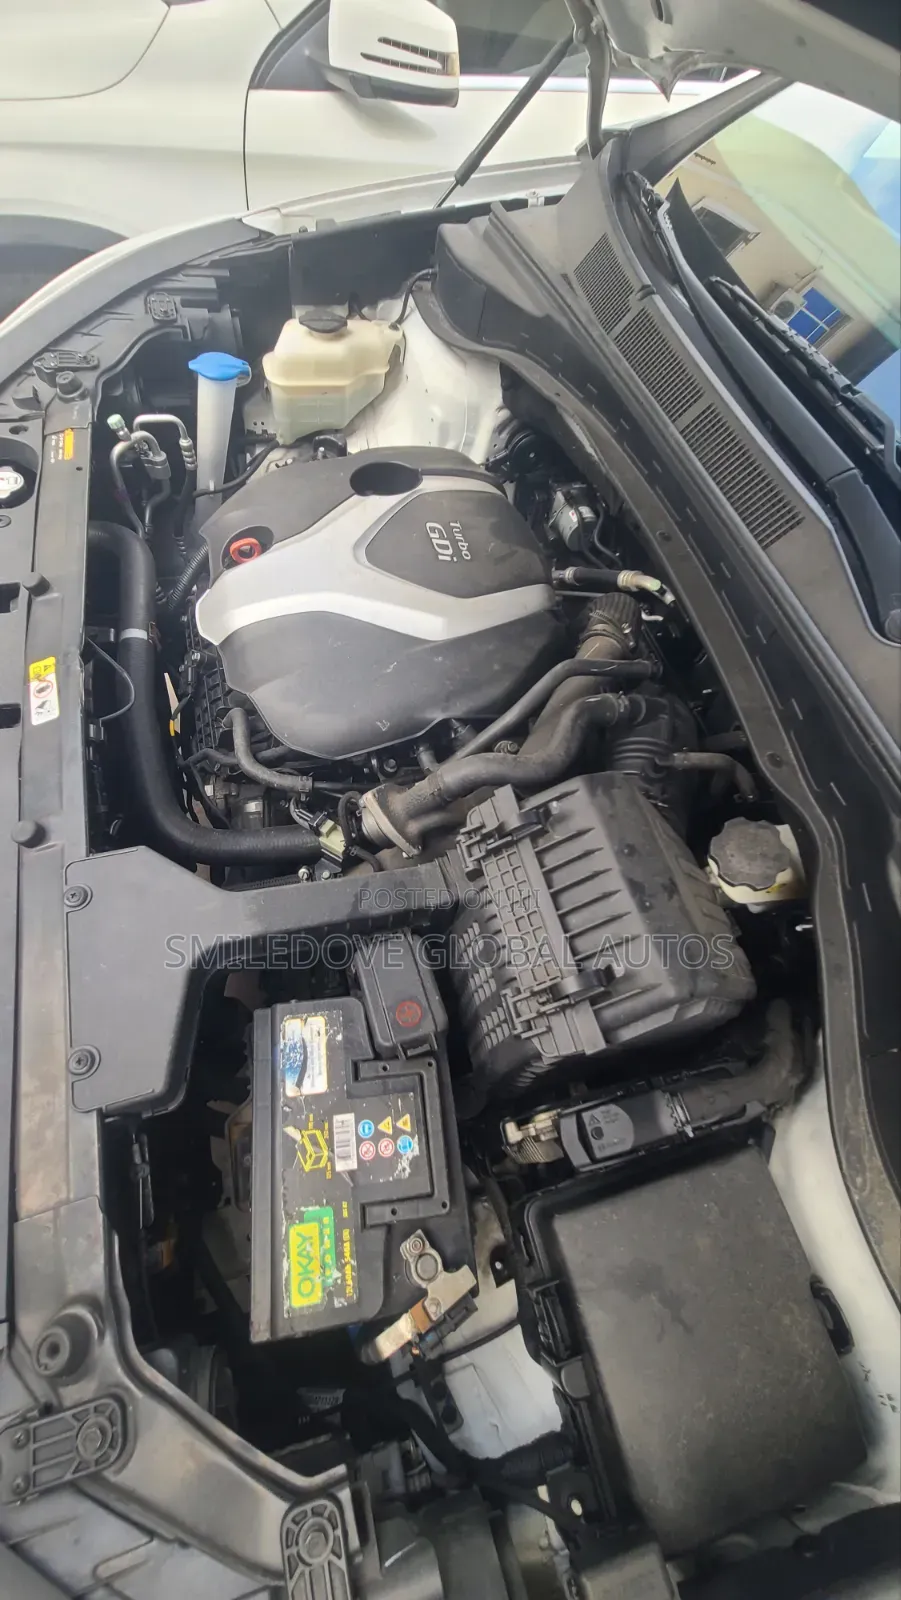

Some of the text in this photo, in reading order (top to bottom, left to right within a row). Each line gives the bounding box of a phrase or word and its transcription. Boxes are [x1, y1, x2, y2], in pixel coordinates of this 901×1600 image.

[425, 522, 457, 562] GDi
[449, 520, 471, 560] Turbo
[295, 1232, 315, 1298] OKAY
